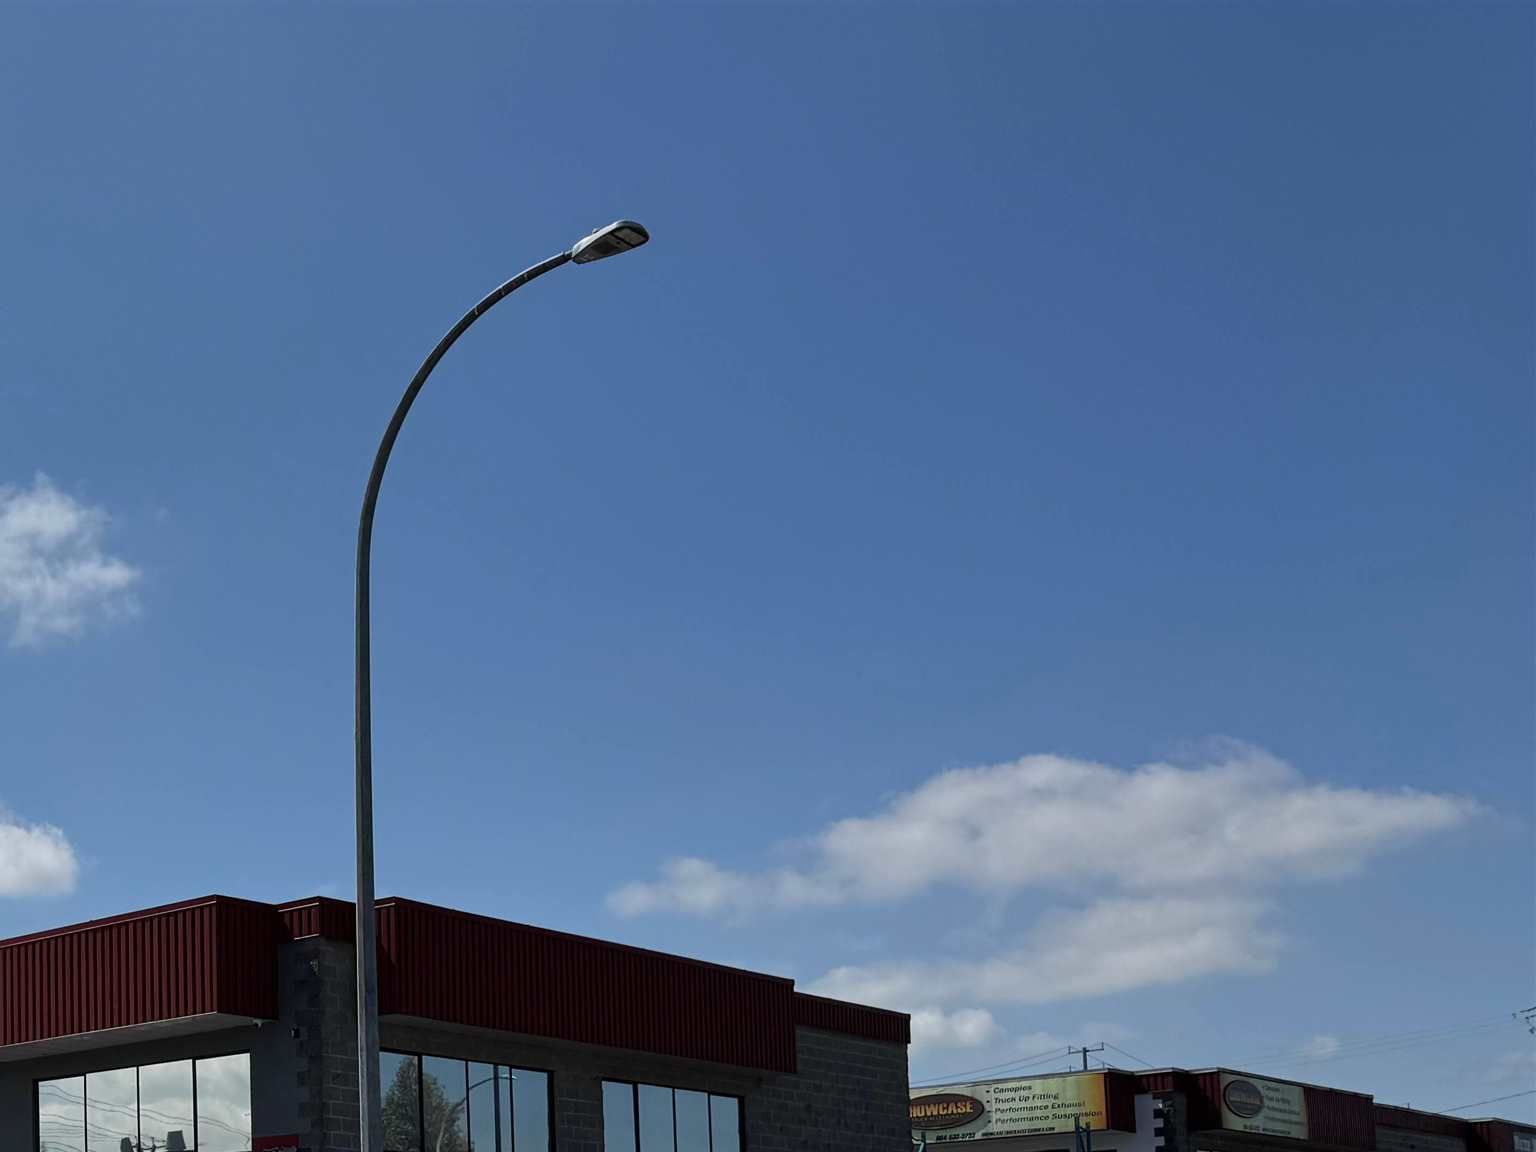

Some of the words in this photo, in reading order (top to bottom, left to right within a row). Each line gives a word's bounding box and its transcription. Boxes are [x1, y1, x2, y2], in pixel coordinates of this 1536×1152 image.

[993, 1085, 1032, 1094] Canopies
[994, 1096, 1016, 1104] Truck
[1032, 1093, 1059, 1101] Fitting
[910, 1101, 974, 1118] HOWCASE
[995, 1105, 1049, 1114] Performance
[1052, 1101, 1086, 1110] Exhaust
[996, 1115, 1050, 1124] Performance
